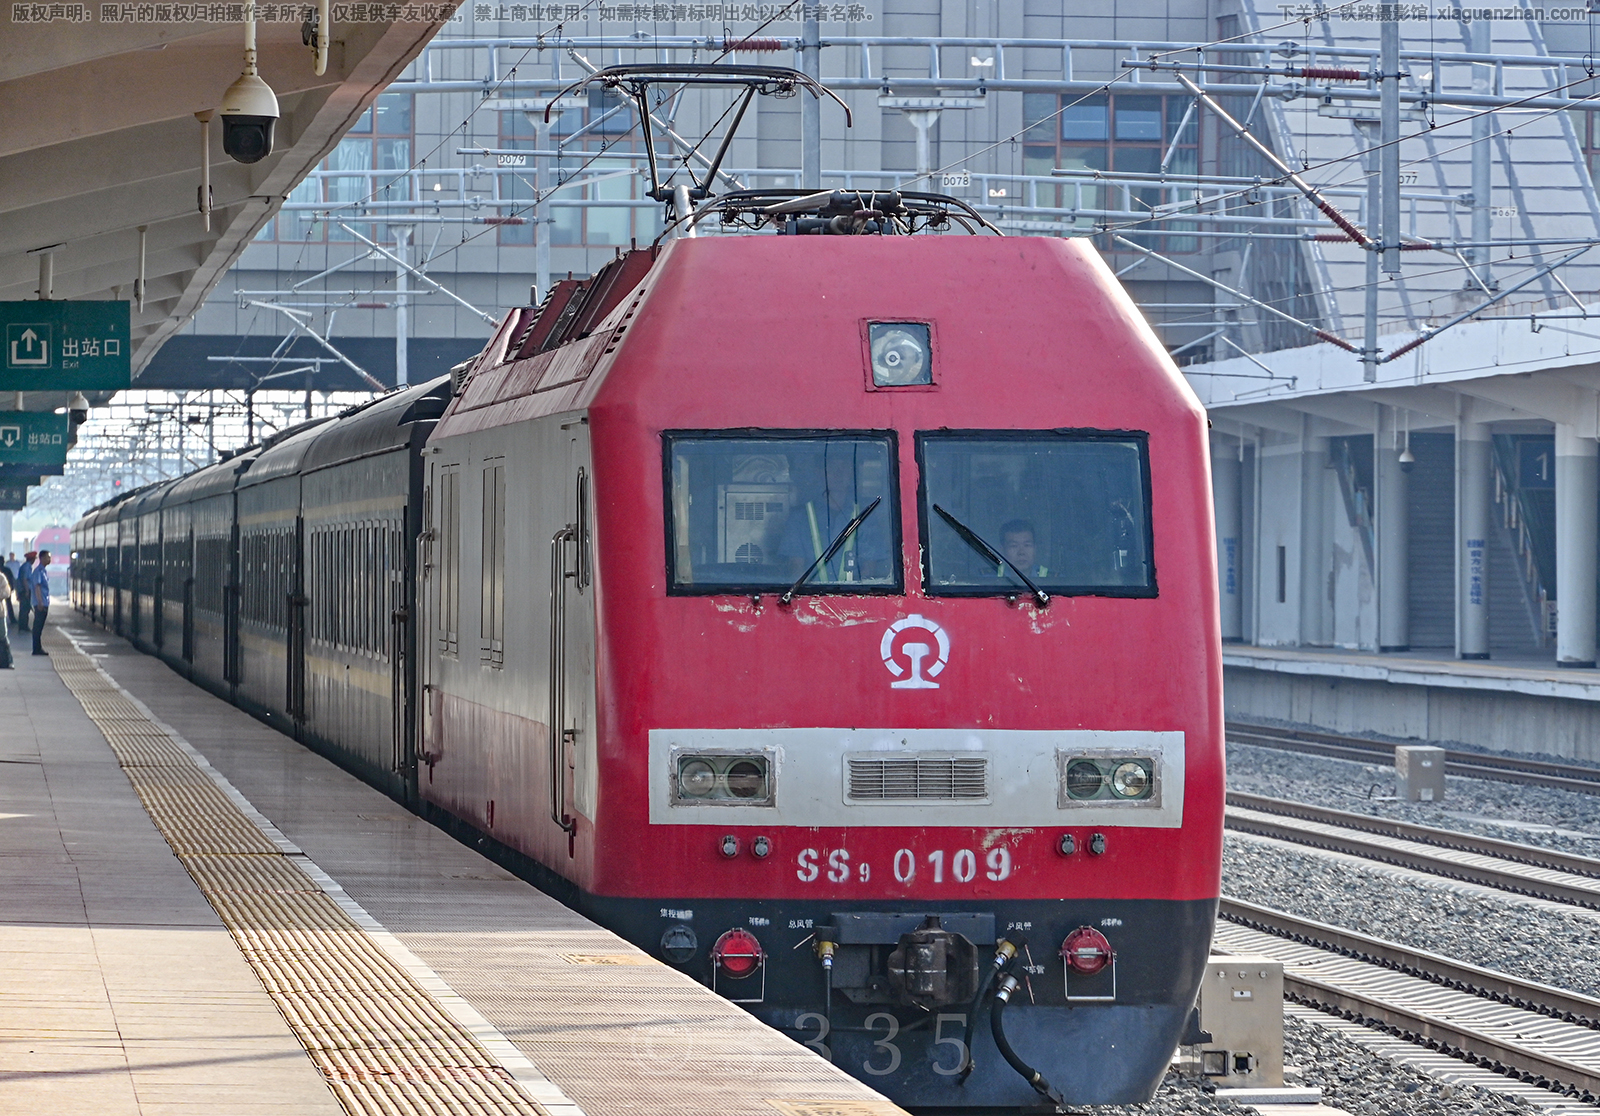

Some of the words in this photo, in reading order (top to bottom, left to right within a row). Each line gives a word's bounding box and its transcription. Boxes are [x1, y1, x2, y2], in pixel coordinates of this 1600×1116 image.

[943, 176, 969, 186] D078
[62, 338, 120, 357] 出站口
[62, 360, 80, 369] Exit
[28, 433, 62, 444] 出站口
[1536, 453, 1548, 480] 1
[893, 848, 1011, 882] 0109
[788, 919, 814, 929] 总风管
